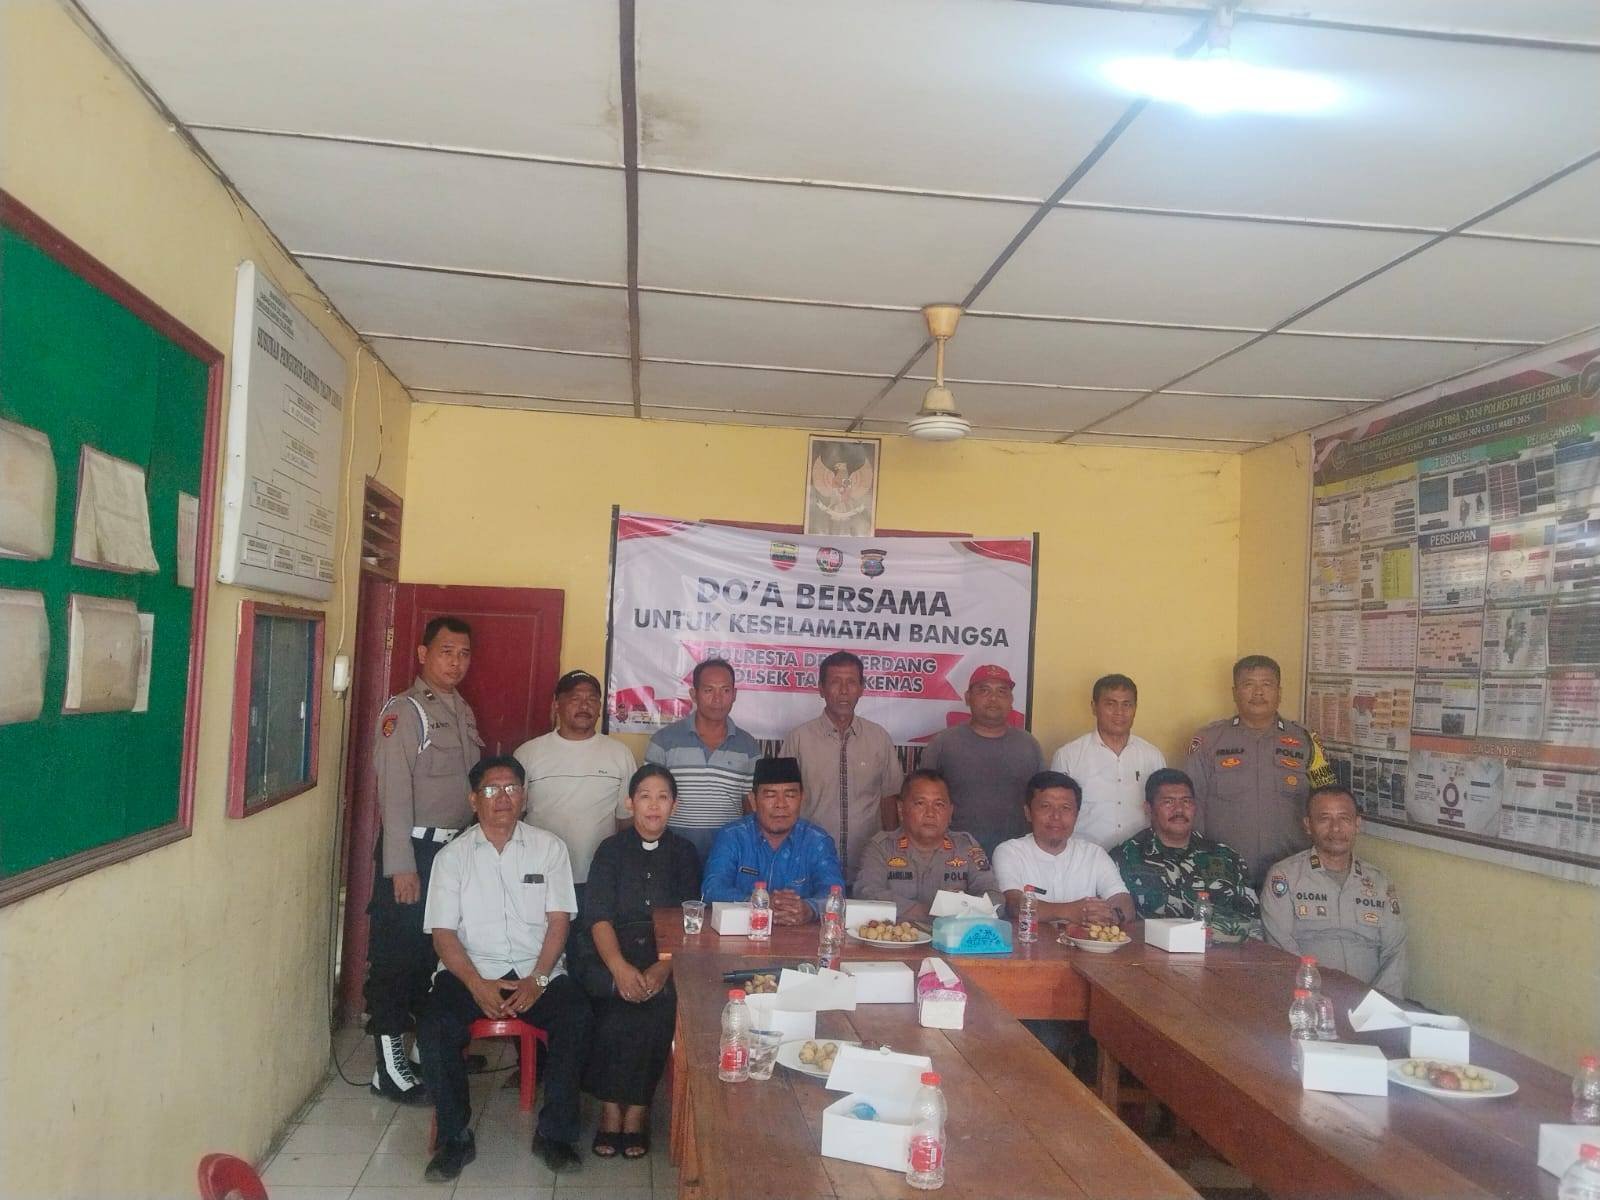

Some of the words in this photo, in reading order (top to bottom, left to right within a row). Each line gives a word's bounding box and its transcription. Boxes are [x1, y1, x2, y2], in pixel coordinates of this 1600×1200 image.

[1430, 529, 1476, 546] PERSIAPAN
[697, 577, 785, 608] DO'A
[797, 583, 952, 617] BERSAMA
[634, 608, 721, 631] UNTUK
[729, 613, 900, 642] KESELAMATAN
[909, 624, 1009, 648] BANGSA
[861, 656, 937, 674] ERDANG
[734, 669, 789, 686] OLSEK
[1355, 897, 1385, 909] POLRI
